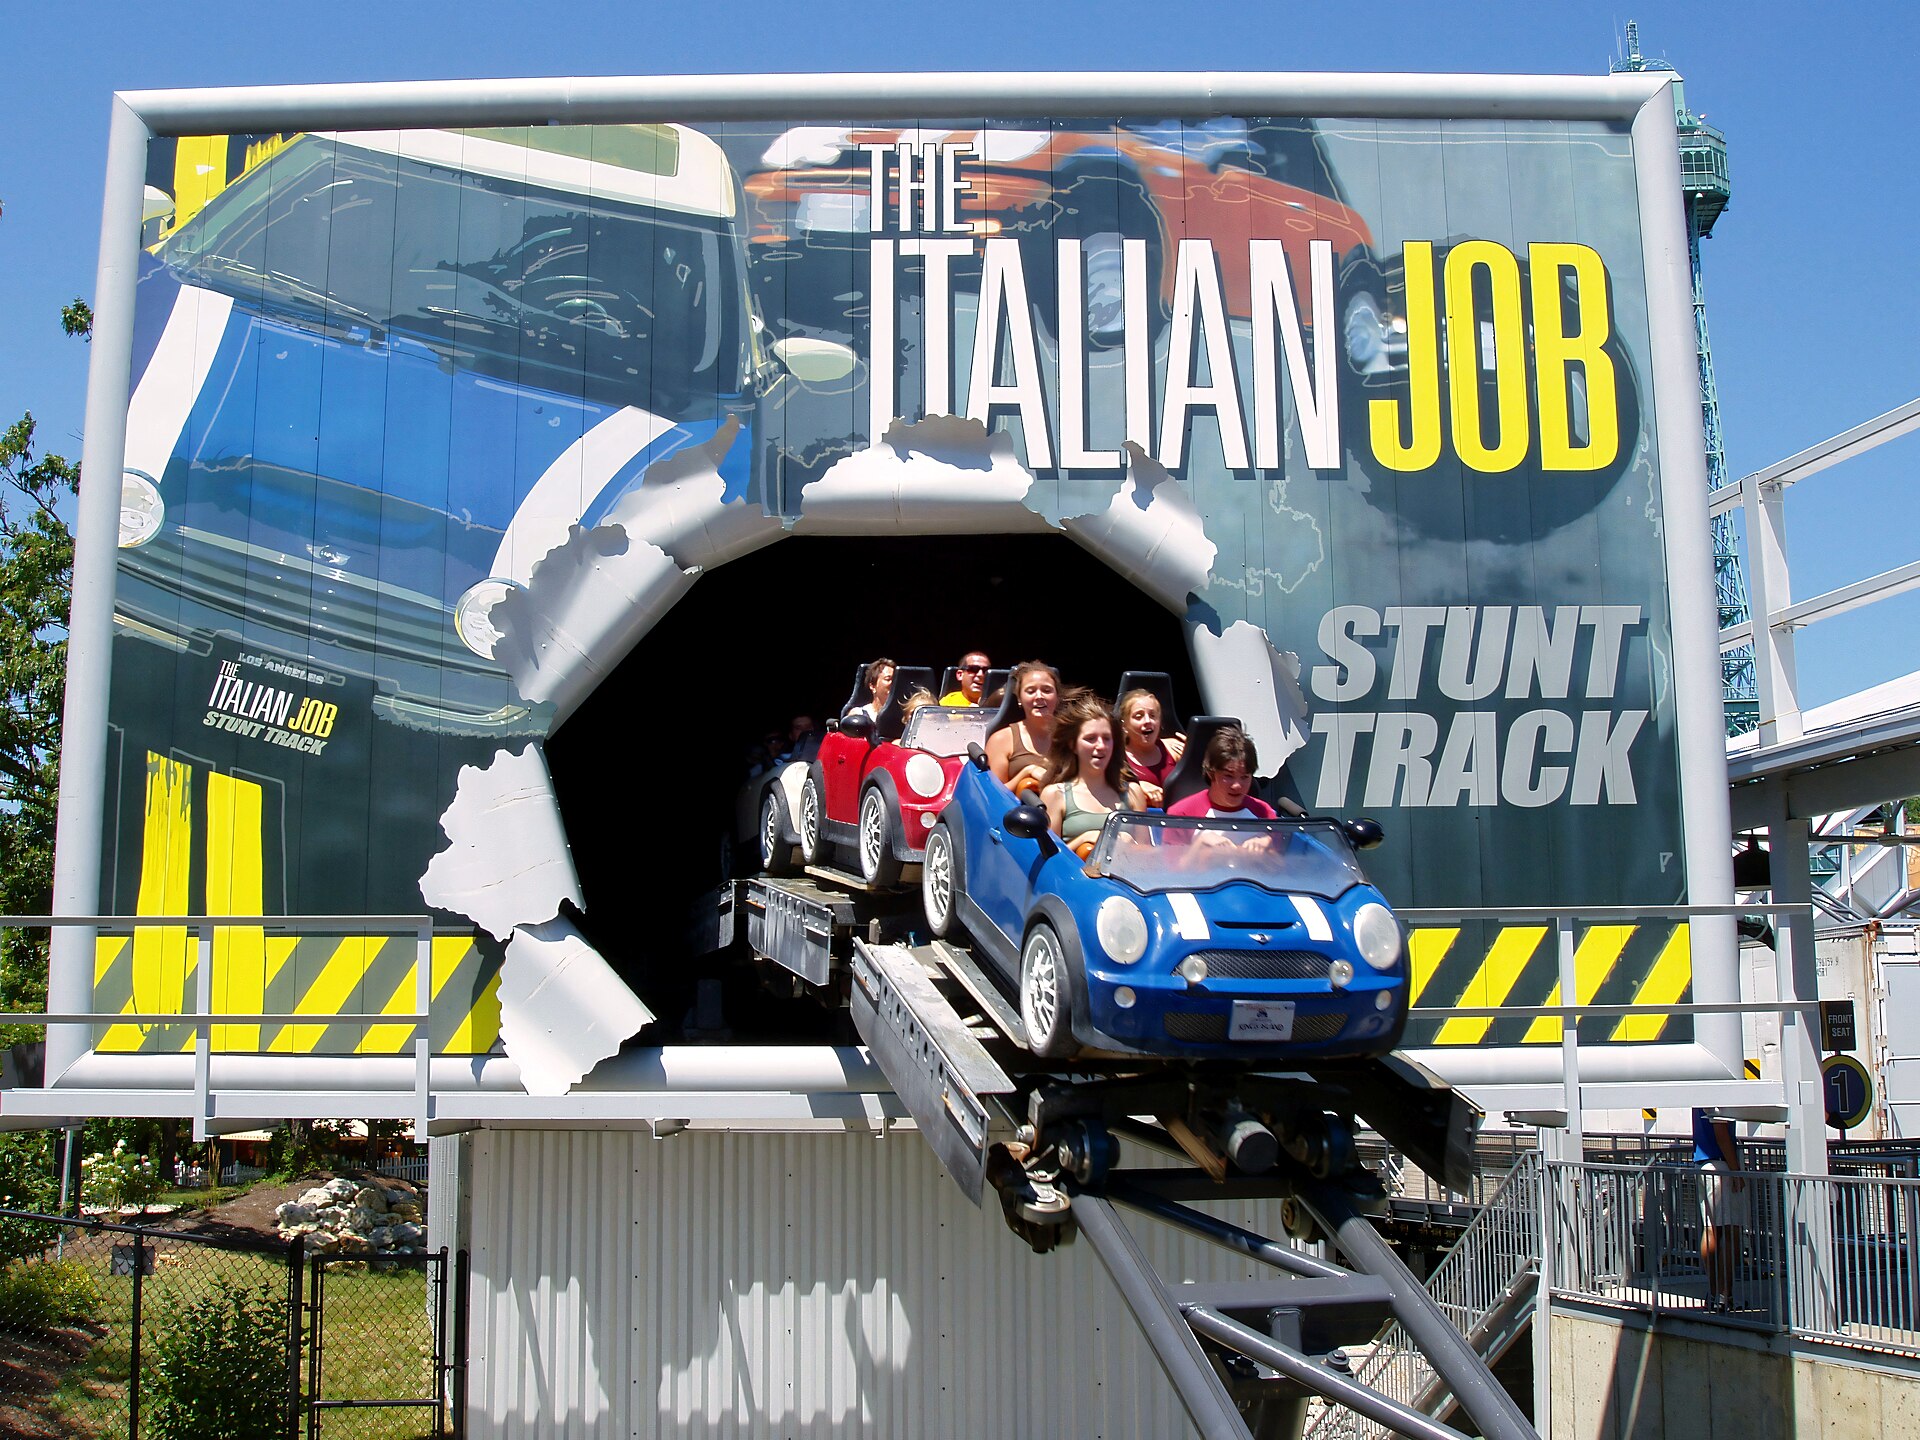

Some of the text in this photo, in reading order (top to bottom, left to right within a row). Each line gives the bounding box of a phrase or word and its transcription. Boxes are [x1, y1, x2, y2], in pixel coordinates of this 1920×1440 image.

[858, 142, 975, 232] THE
[869, 238, 1619, 472] ITALIAN JOB
[219, 659, 242, 679] THE
[238, 652, 325, 685] LOS ANGELES
[1311, 604, 1642, 702] STUNT
[208, 674, 338, 738] ITALIAN JOB
[202, 711, 328, 756] STUNT TRACK
[1311, 709, 1649, 808] TRACK
[1828, 1014, 1853, 1024] FRONT
[1831, 1027, 1851, 1037] SEAT
[1831, 1069, 1850, 1113] 1
